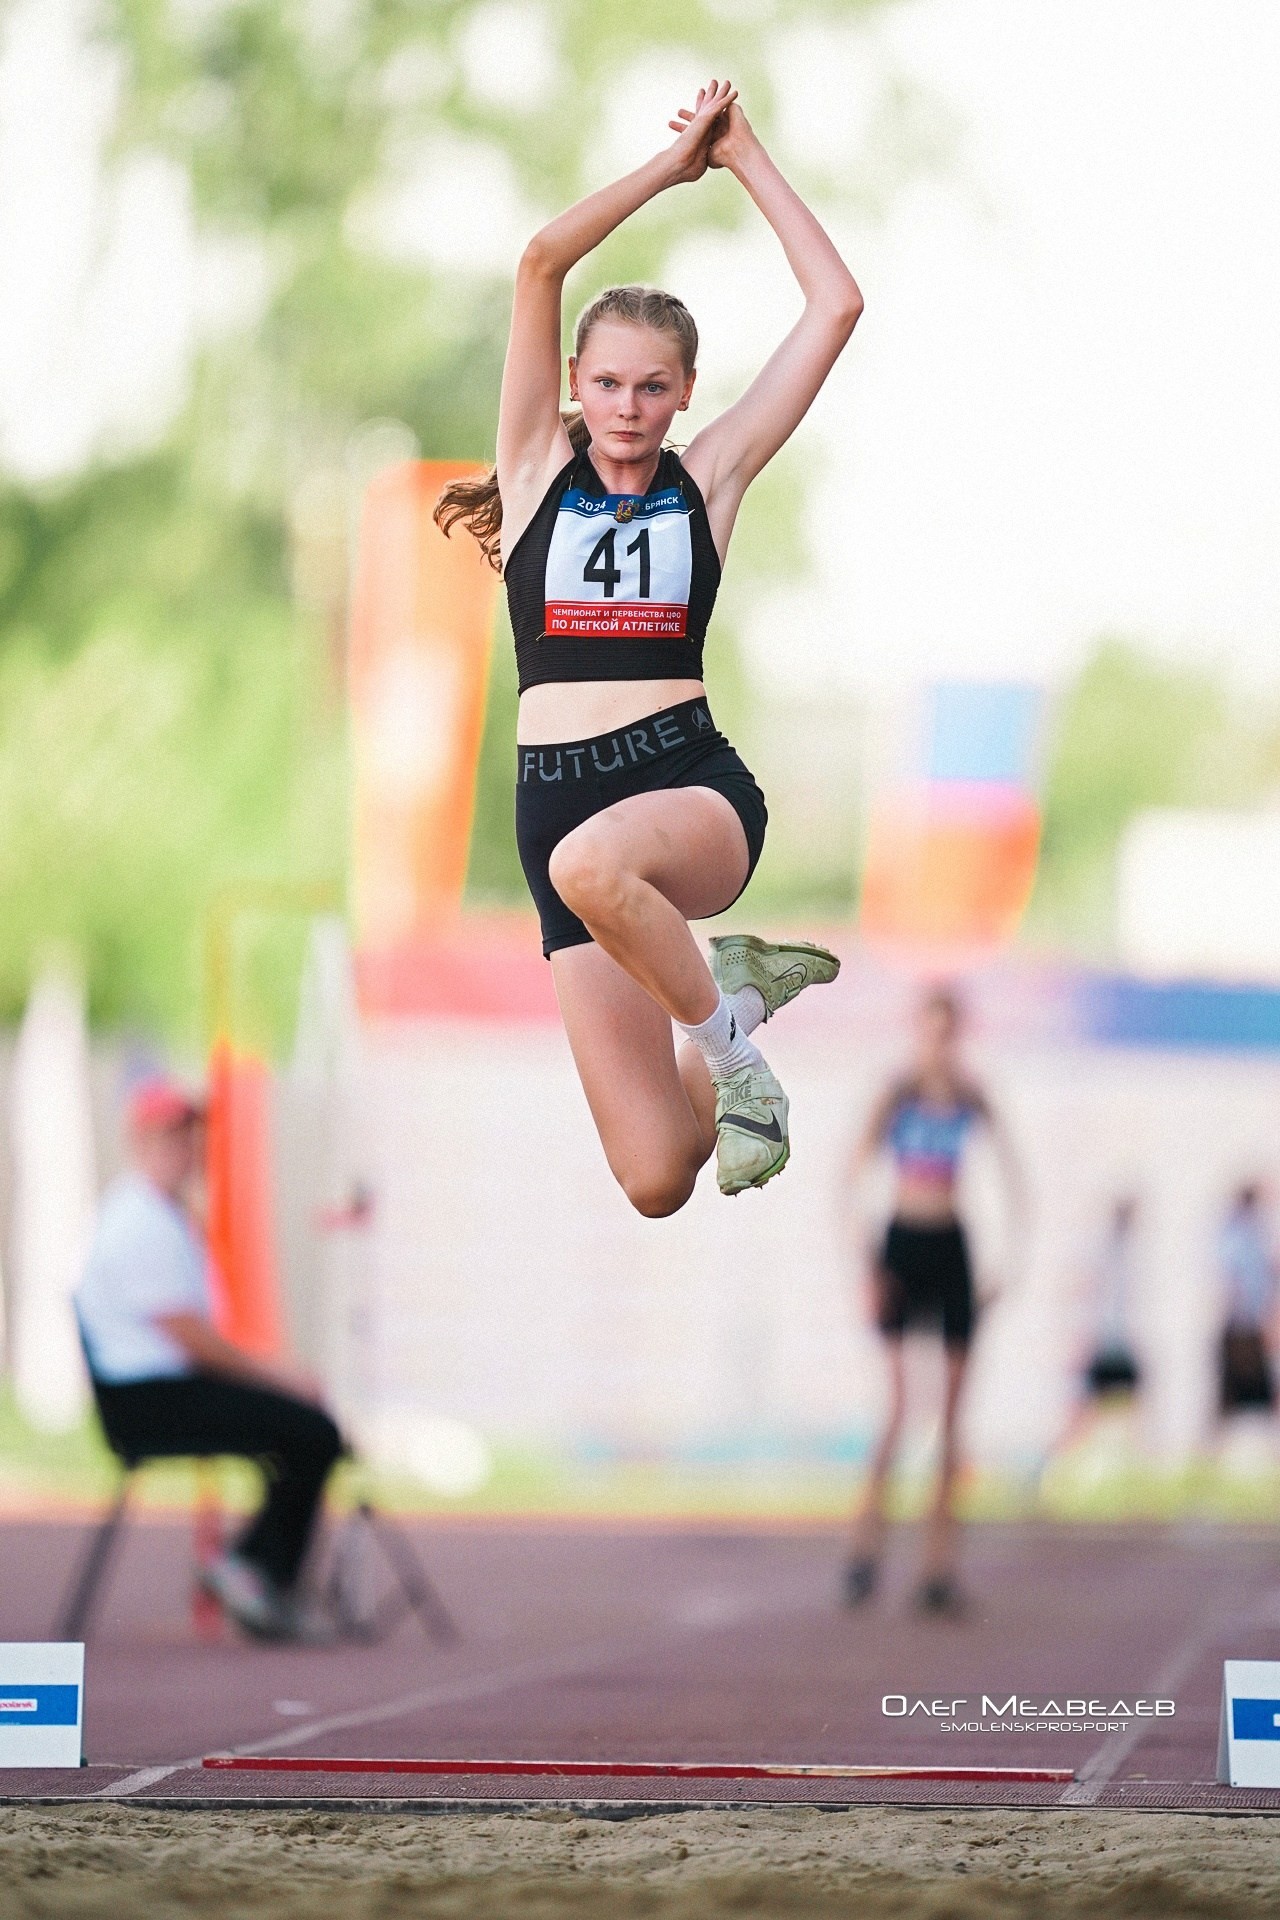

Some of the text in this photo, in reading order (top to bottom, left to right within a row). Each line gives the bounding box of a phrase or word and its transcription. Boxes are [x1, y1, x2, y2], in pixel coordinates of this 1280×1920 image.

[577, 496, 679, 511] 2024 БРЯНСК
[583, 528, 651, 598] 41
[552, 609, 602, 618] ЧЕМПИОНАТ
[612, 610, 664, 619] ПЕРВЕНСТВА
[666, 612, 681, 620] ЦФО
[552, 618, 680, 631] ПО ЛЕГКОЙ АТЛЕТИКЕ
[523, 714, 685, 782] FUTURE
[721, 1086, 751, 1110] NIKE
